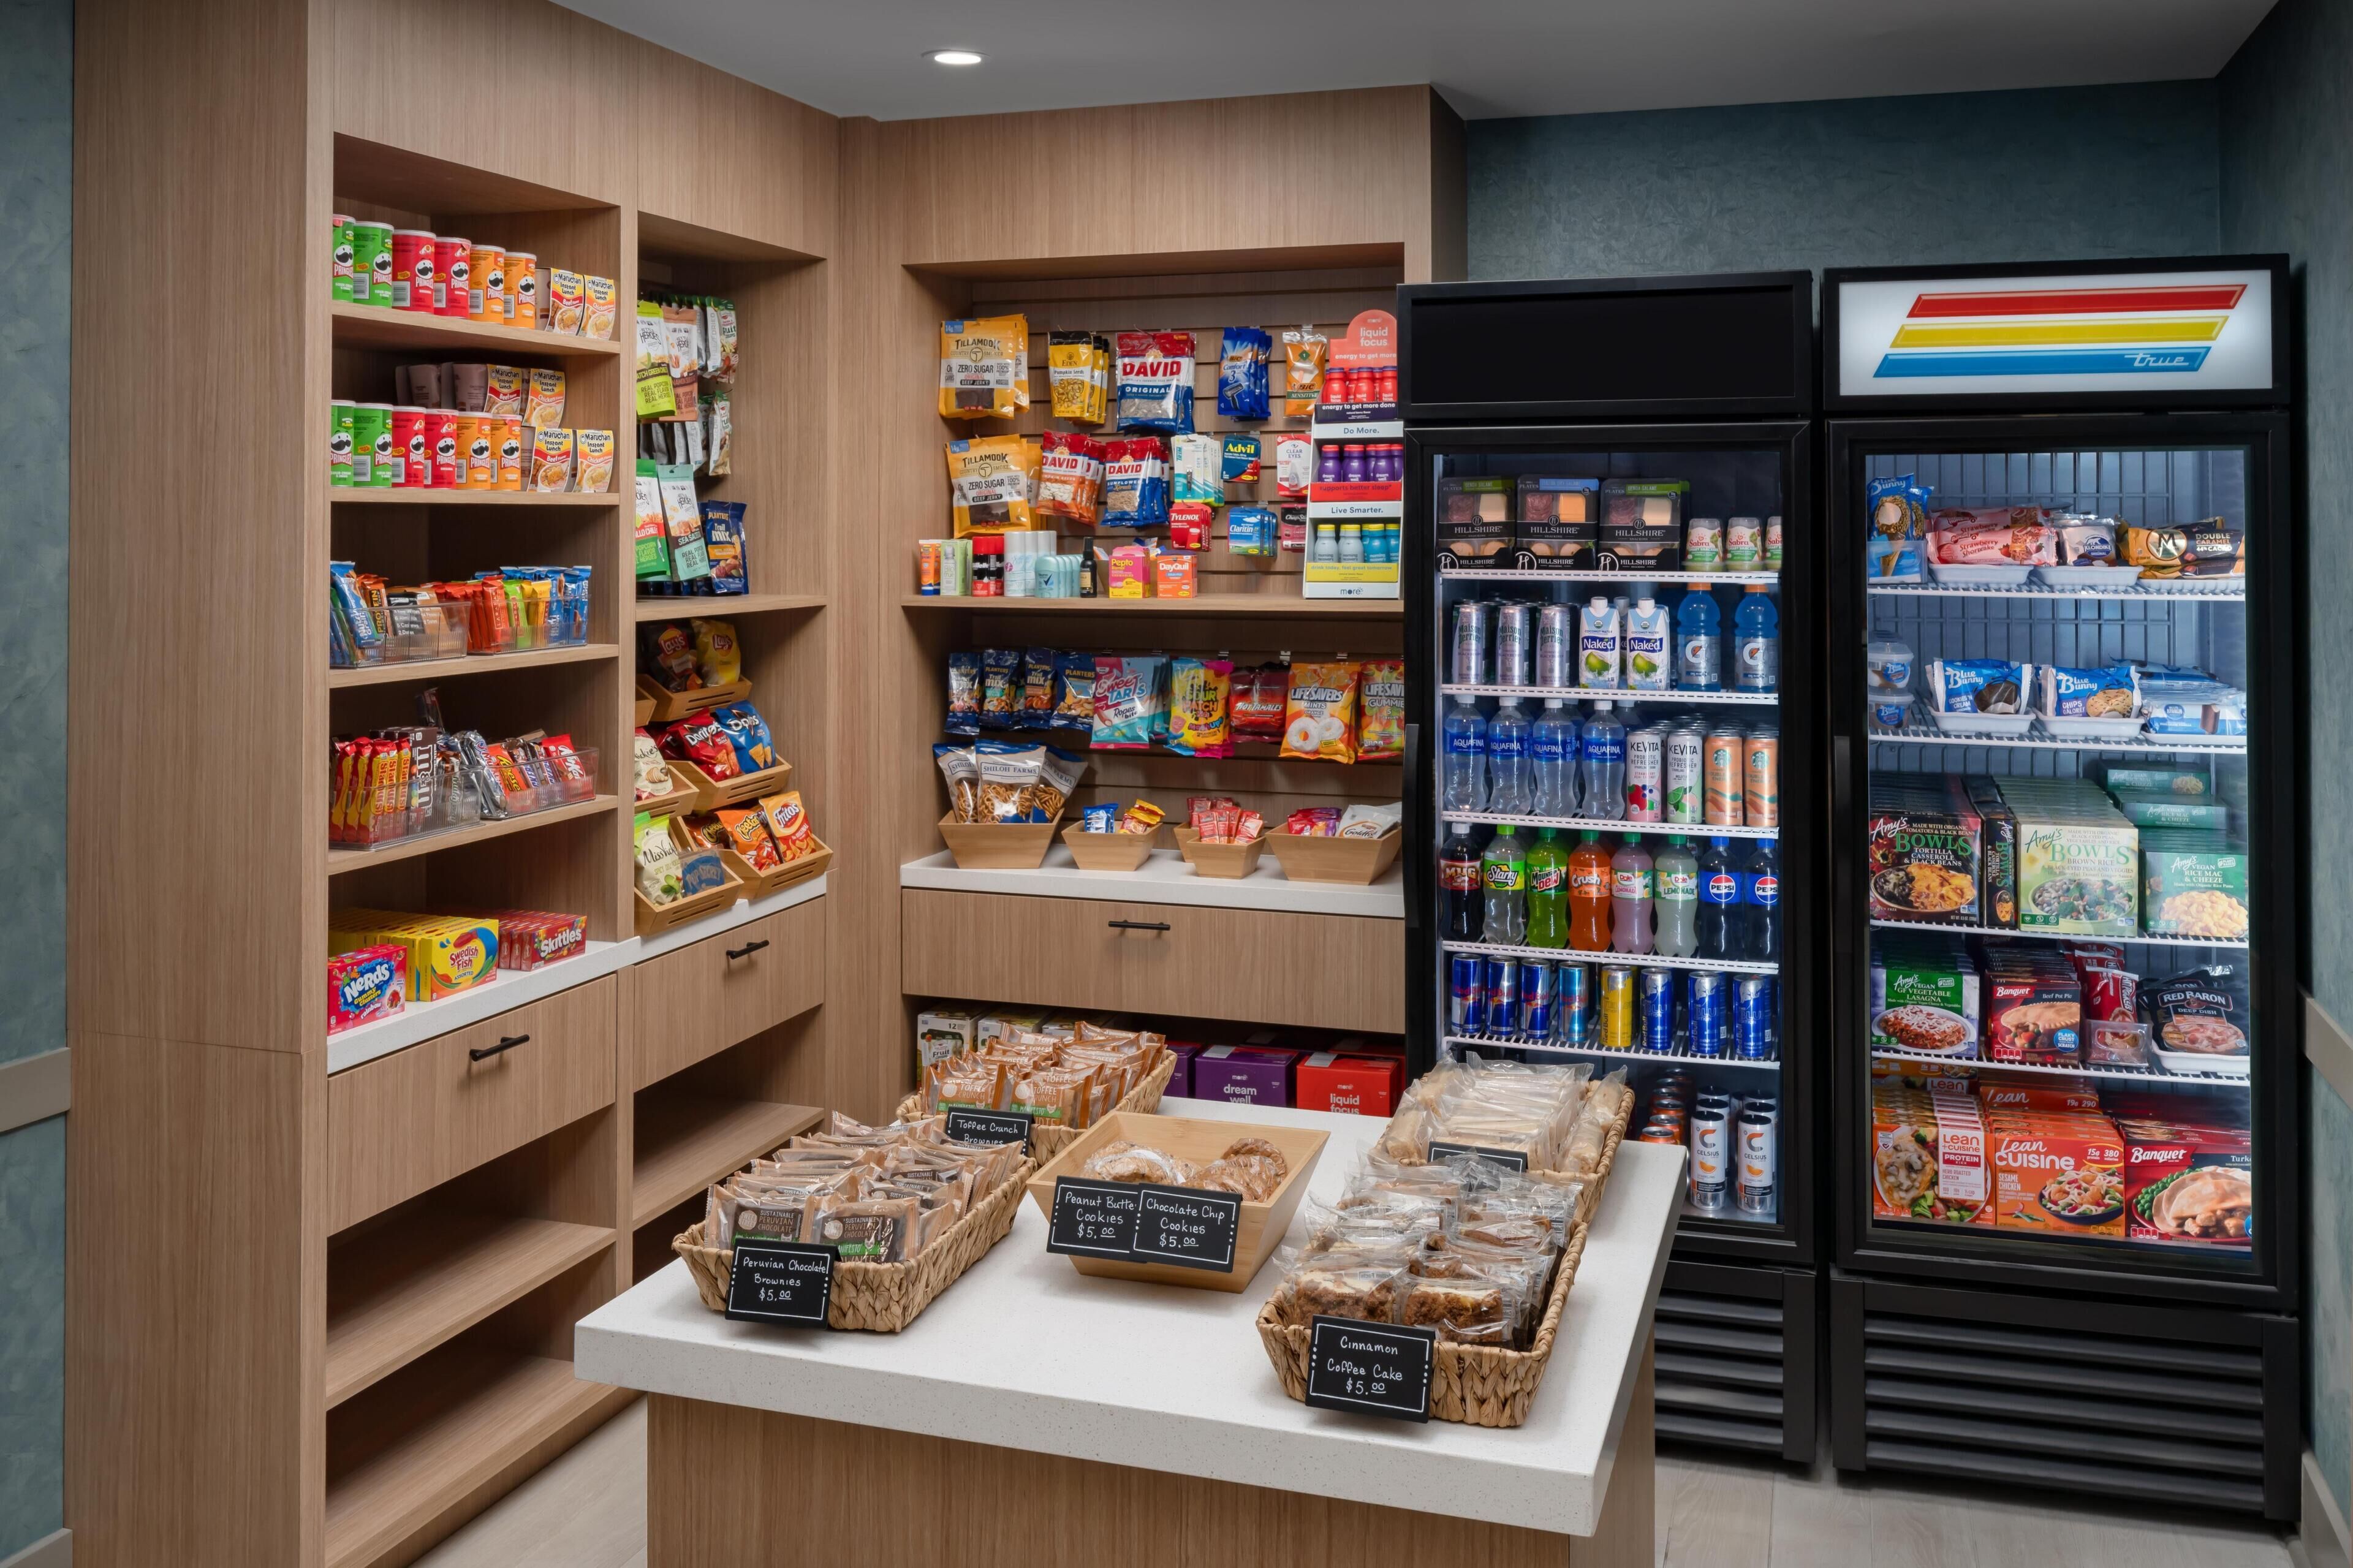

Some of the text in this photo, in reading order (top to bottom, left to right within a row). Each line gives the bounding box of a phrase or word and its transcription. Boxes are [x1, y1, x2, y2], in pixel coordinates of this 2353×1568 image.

[558, 273, 582, 286] Maruchan
[1360, 327, 1388, 337] liquid
[955, 339, 1001, 350] TILLAMOOK
[1122, 360, 1181, 377] DAVID
[1226, 444, 1254, 453] Advil
[1108, 464, 1142, 474] DAVID
[1230, 524, 1252, 532] Claritin
[1960, 539, 1998, 551] Strawberry
[1159, 562, 1189, 572] DayQuil
[1584, 638, 1613, 649] Naked
[1292, 687, 1308, 700] LIFE
[1113, 706, 1135, 718] Ropes
[1453, 739, 1484, 748] AQUAFINA
[1014, 766, 1037, 775] FARMS
[774, 804, 800, 827] Fritos
[1895, 833, 1972, 855] BOWLS
[2025, 828, 2063, 853] Amy's
[1446, 868, 1476, 877] MUG
[1487, 865, 1518, 885] Starry
[1572, 874, 1601, 887] Crush
[540, 929, 582, 957] Skittles
[449, 946, 479, 967] Swedish
[455, 958, 473, 972] Fish
[454, 971, 474, 980] ASSORTED
[1909, 988, 1951, 997] VEGETABLE
[2163, 991, 2226, 1004] RED BARON
[360, 1001, 382, 1020] rainbow
[1223, 1084, 1257, 1096] dream
[1330, 1094, 1360, 1106] liquid
[957, 1119, 1018, 1134] Toffee Crunch
[1943, 1134, 1979, 1145] Lean
[2131, 1147, 2188, 1164] Banquet
[1998, 1173, 2018, 1182] SESAME
[1998, 1182, 2020, 1191] CHICKEN
[1065, 1192, 1102, 1207] Peanut
[760, 1210, 794, 1219] SUSTAINABLE
[1076, 1209, 1123, 1224] Cookies
[1146, 1198, 1225, 1224] Chocolate Chip
[759, 1216, 792, 1225] PERUVIAN
[1161, 1218, 1206, 1235] Cookies
[757, 1223, 792, 1233] CHOCOLATE
[1077, 1222, 1115, 1240] $5.00
[1160, 1233, 1199, 1248] $5.00
[743, 1257, 827, 1274] Peruvian Chocolate
[754, 1273, 801, 1287] Brownies
[759, 1289, 792, 1301] $5.00
[1339, 1336, 1398, 1356] Cinnamon
[1327, 1358, 1403, 1382] Coffee Cake
[1346, 1377, 1386, 1395] $5.00
